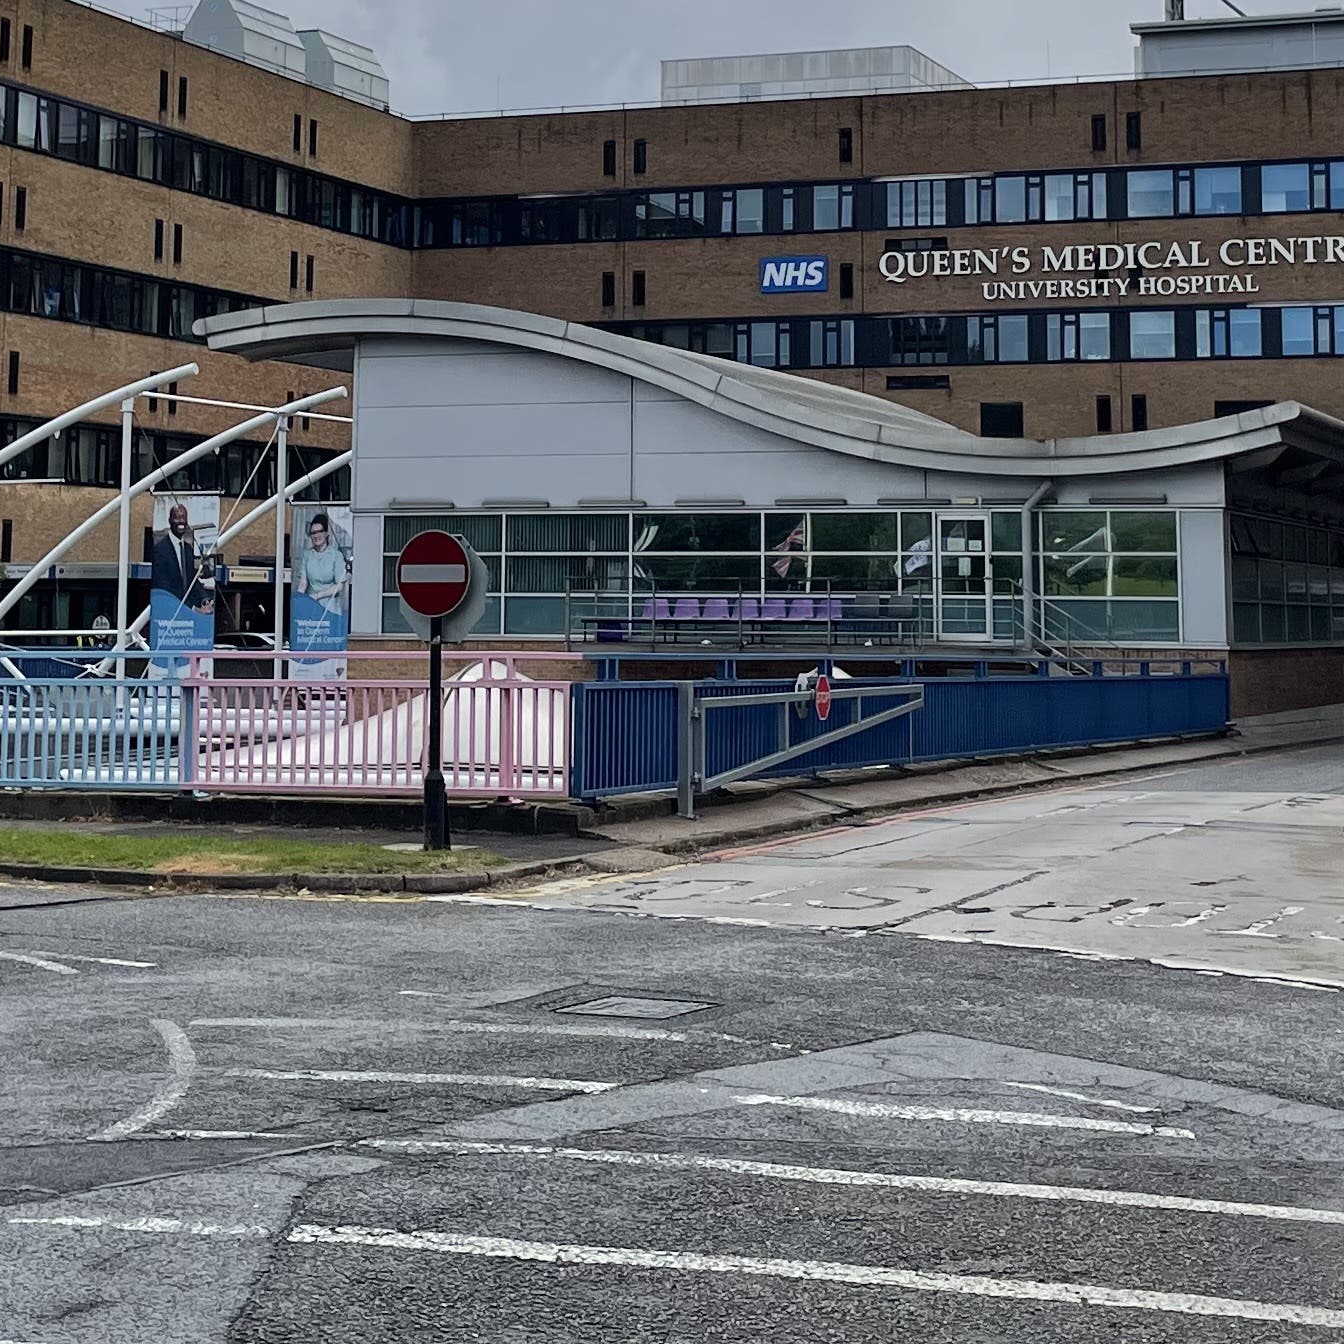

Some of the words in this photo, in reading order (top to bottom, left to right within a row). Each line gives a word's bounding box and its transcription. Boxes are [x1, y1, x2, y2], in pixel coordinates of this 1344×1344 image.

[762, 260, 825, 288] NHS
[878, 245, 1032, 283] QUEEN'S
[1041, 240, 1210, 272] MEDICAL
[981, 277, 1131, 301] UNIVERSITY
[1138, 273, 1260, 296] HOSPITAL
